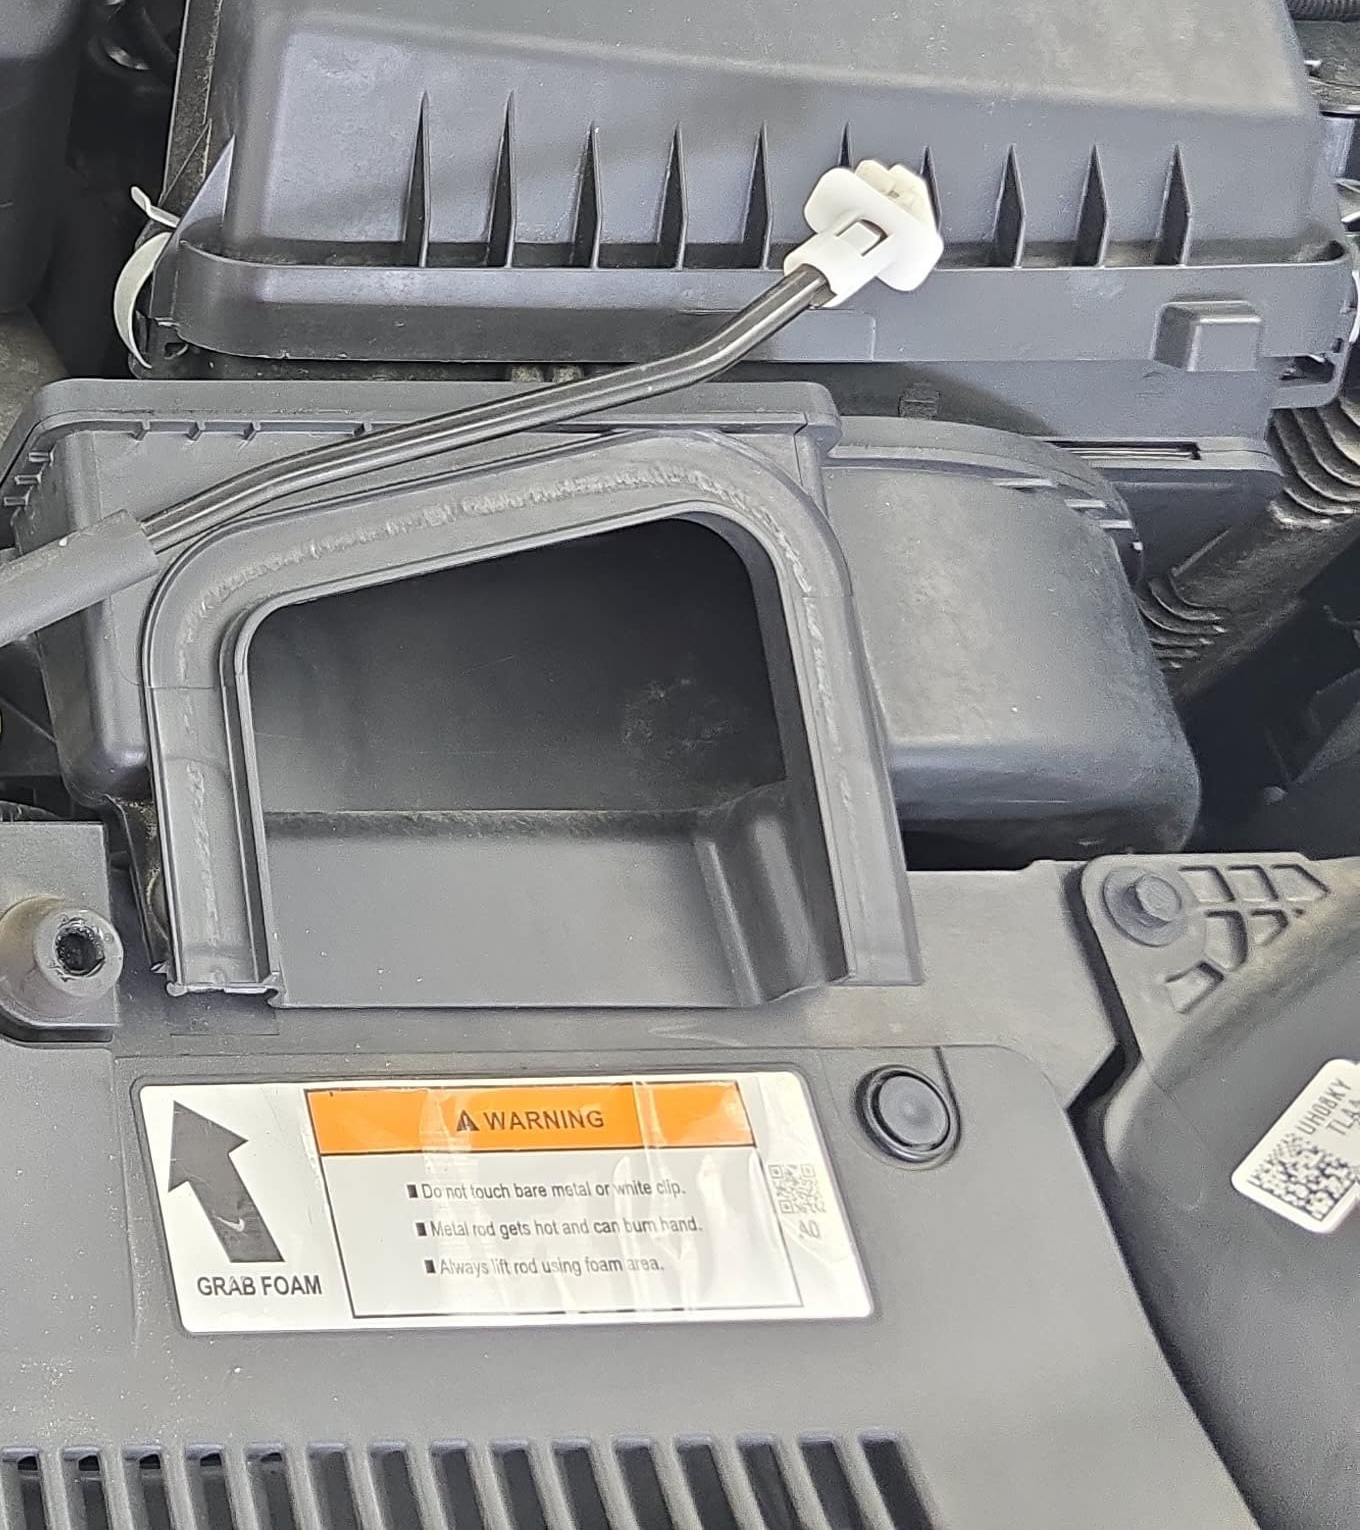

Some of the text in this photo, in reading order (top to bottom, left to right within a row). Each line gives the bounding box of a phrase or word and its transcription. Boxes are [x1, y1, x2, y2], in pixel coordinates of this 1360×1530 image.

[483, 1109, 605, 1131] WARNING
[421, 1183, 442, 1199] Do
[446, 1184, 468, 1199] not
[470, 1182, 511, 1199] touch
[513, 1182, 548, 1198] bare
[551, 1181, 592, 1197] metal
[595, 1183, 610, 1196] or
[656, 1178, 686, 1199] clip.
[430, 1220, 469, 1237] Metal
[472, 1221, 496, 1237] rod
[499, 1221, 531, 1240] gets
[534, 1219, 559, 1235] hot
[562, 1218, 590, 1235] and
[593, 1220, 621, 1234] can
[660, 1215, 704, 1232] hand.
[439, 1255, 665, 1278] Always lift rod using foam area.
[196, 1274, 323, 1297] GRAB FOAM
